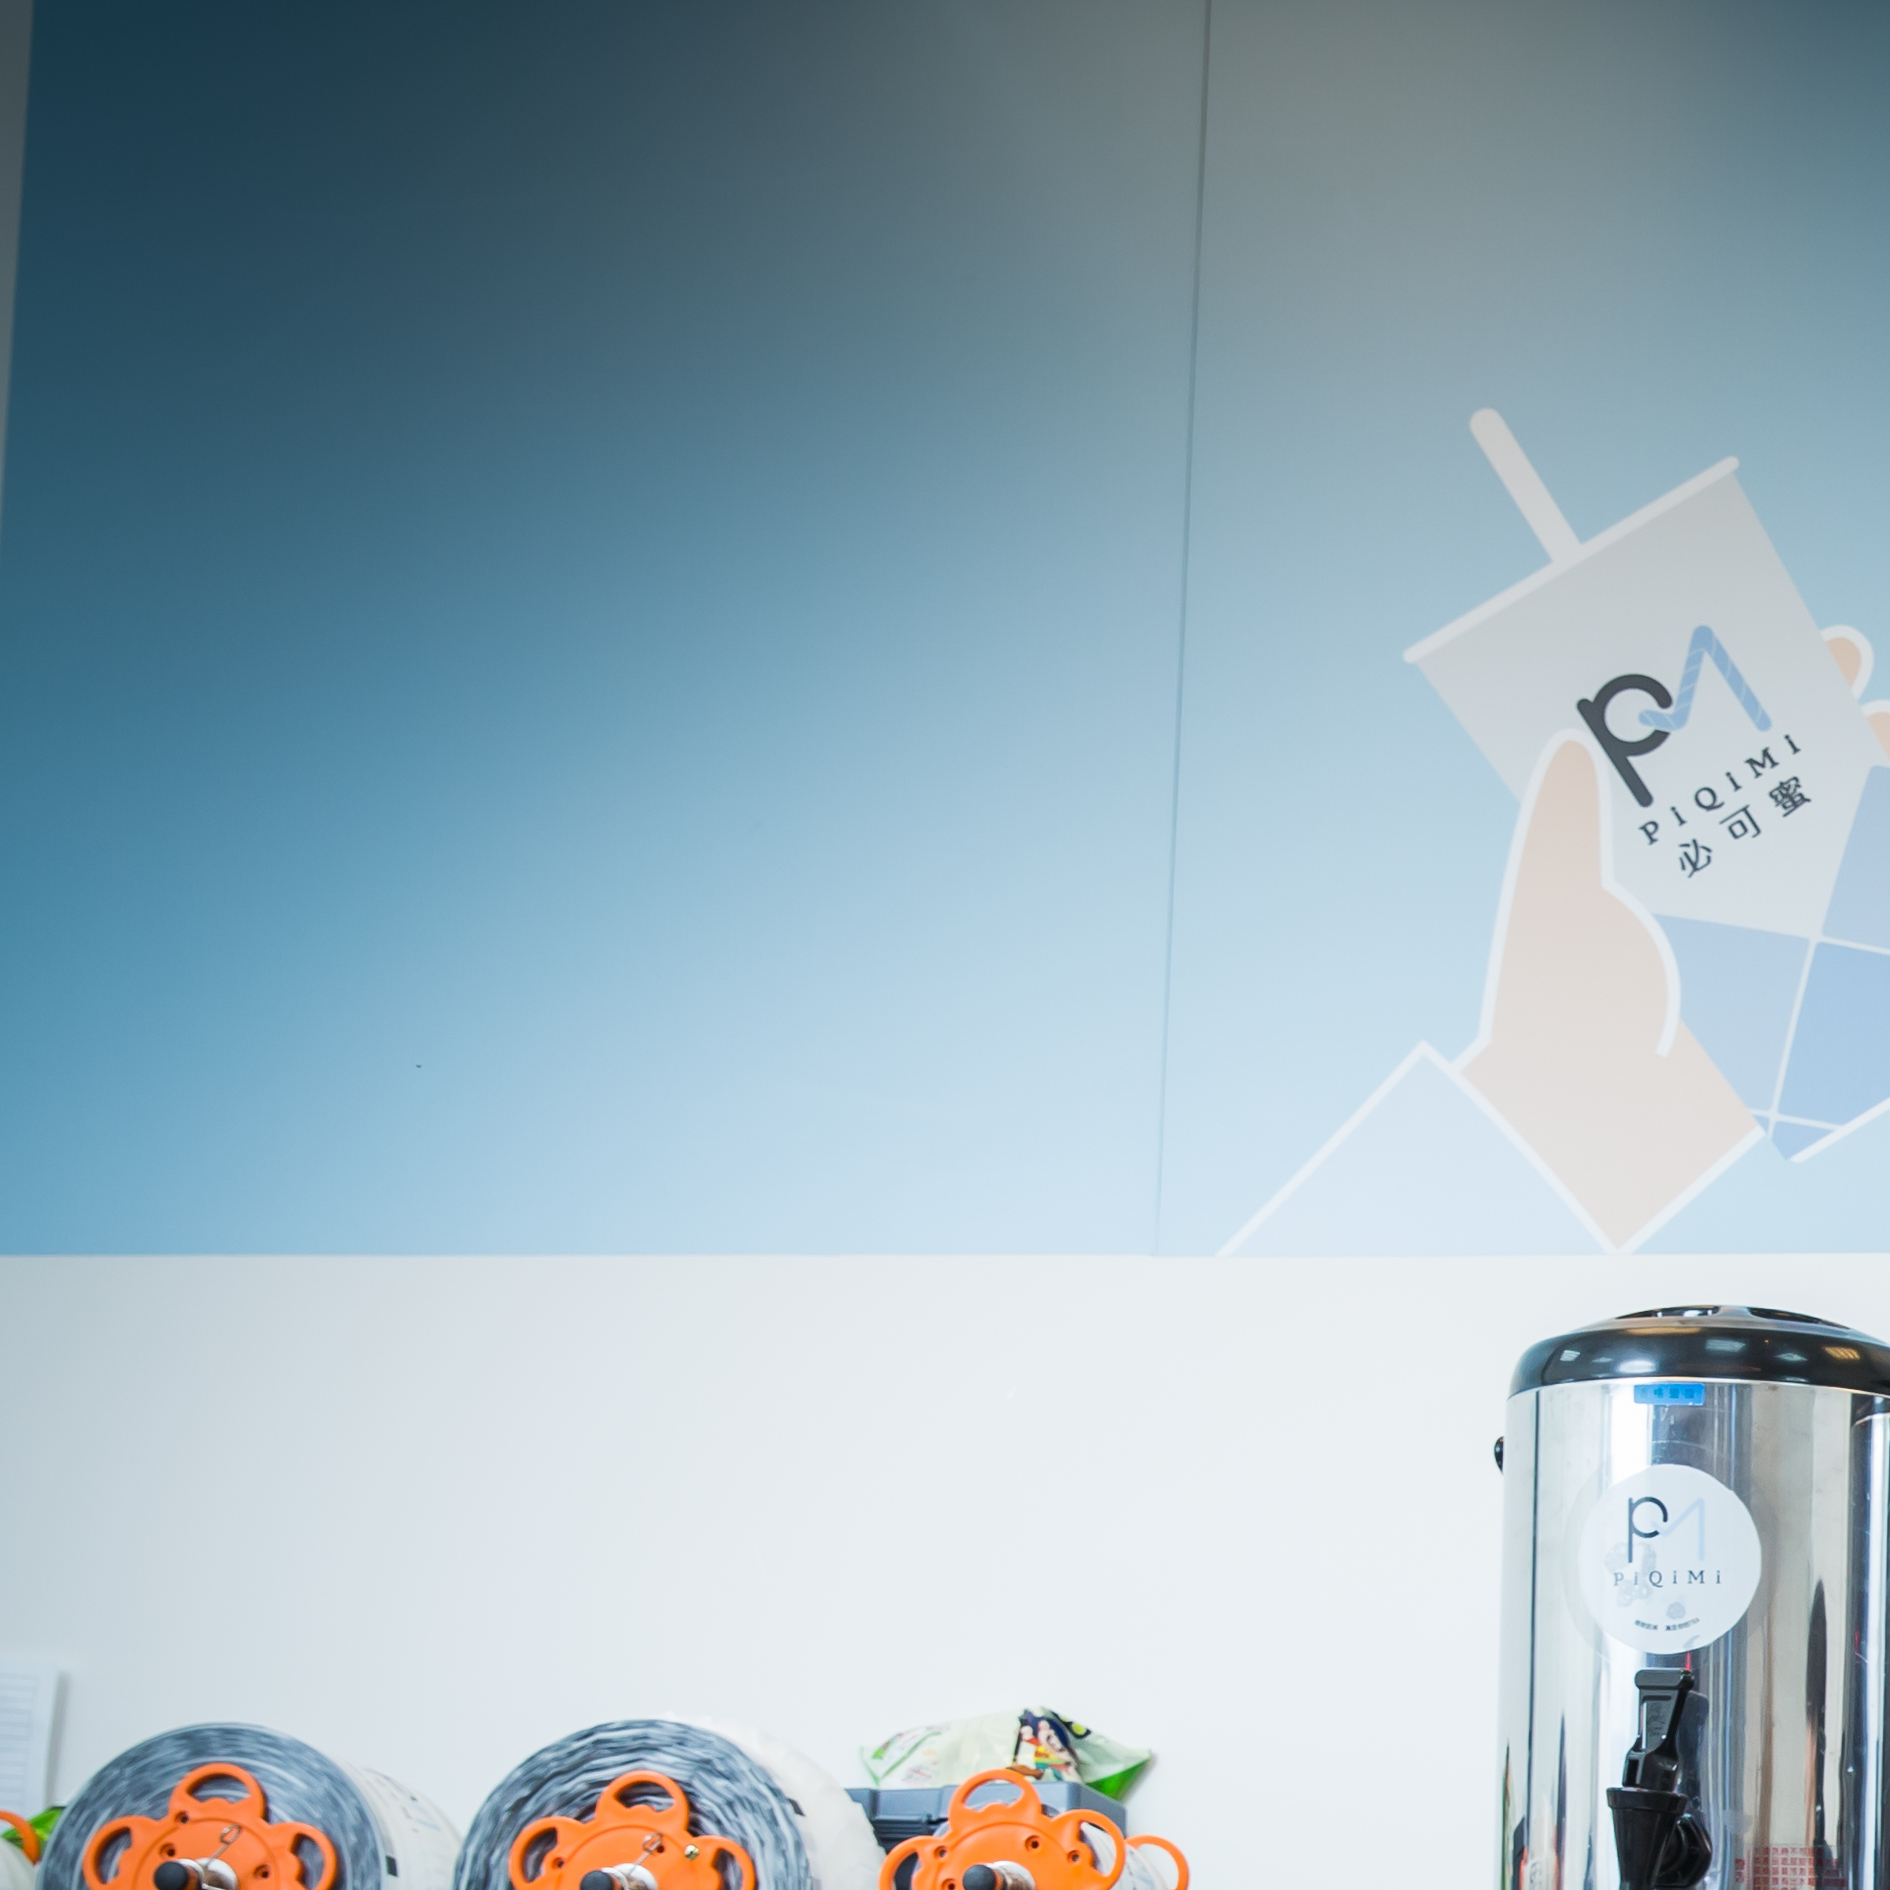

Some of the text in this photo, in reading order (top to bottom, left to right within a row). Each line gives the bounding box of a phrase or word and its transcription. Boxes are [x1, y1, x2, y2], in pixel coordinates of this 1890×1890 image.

[1679, 776, 1811, 878] 必可蜜
[1613, 1570, 1722, 1588] PiQiMi
